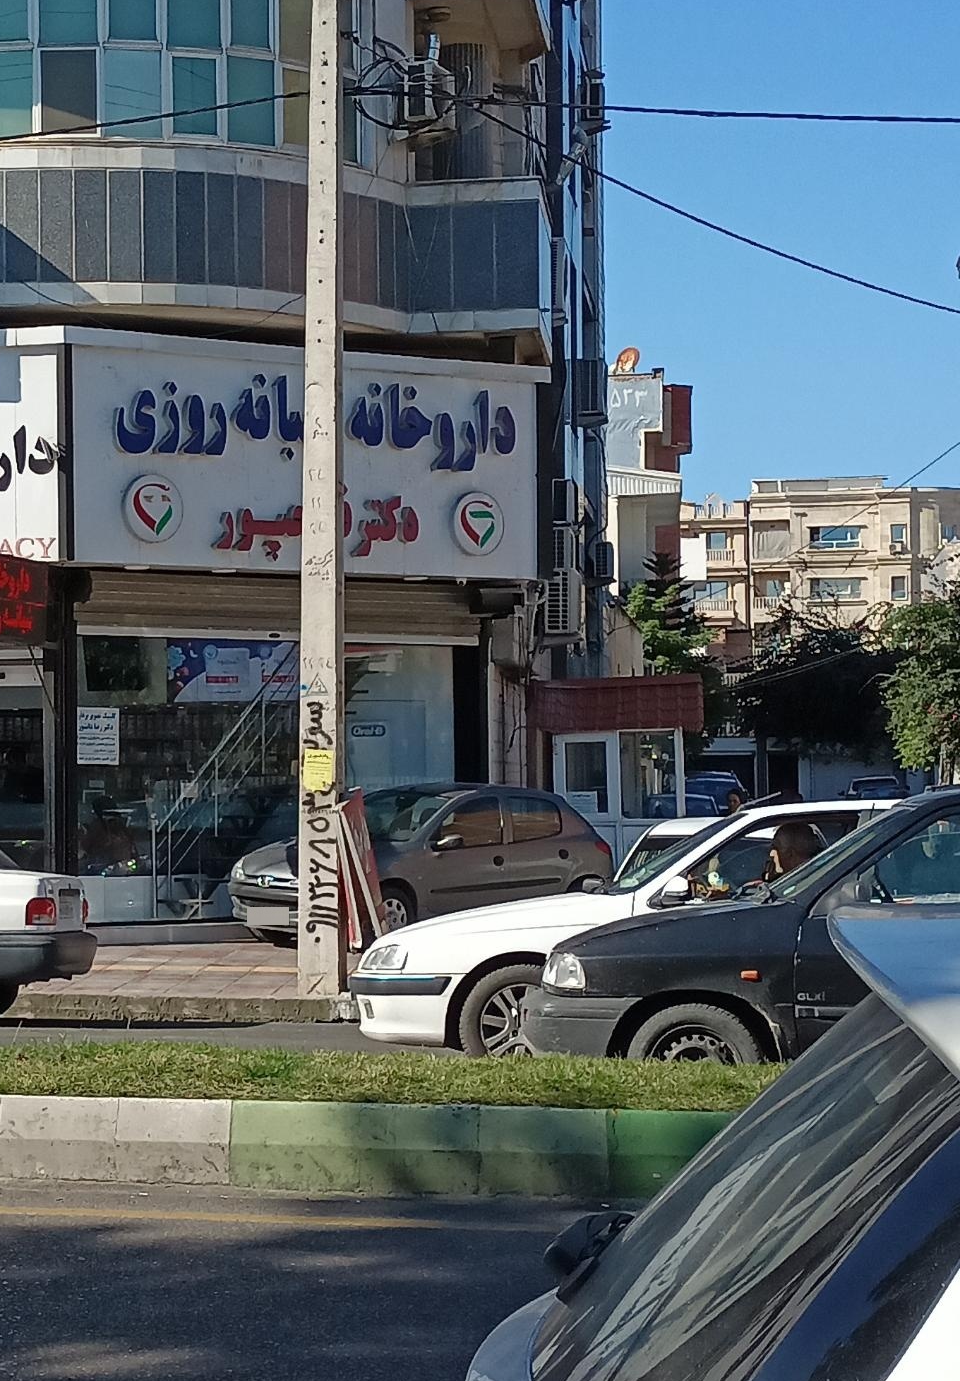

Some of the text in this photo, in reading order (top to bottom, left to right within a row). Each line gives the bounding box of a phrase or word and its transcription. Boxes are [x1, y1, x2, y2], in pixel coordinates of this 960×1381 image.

[231, 374, 304, 462] بانه
[346, 382, 517, 473] داروخانه
[351, 496, 420, 557] دکتر
[352, 725, 385, 737] Oral-B
